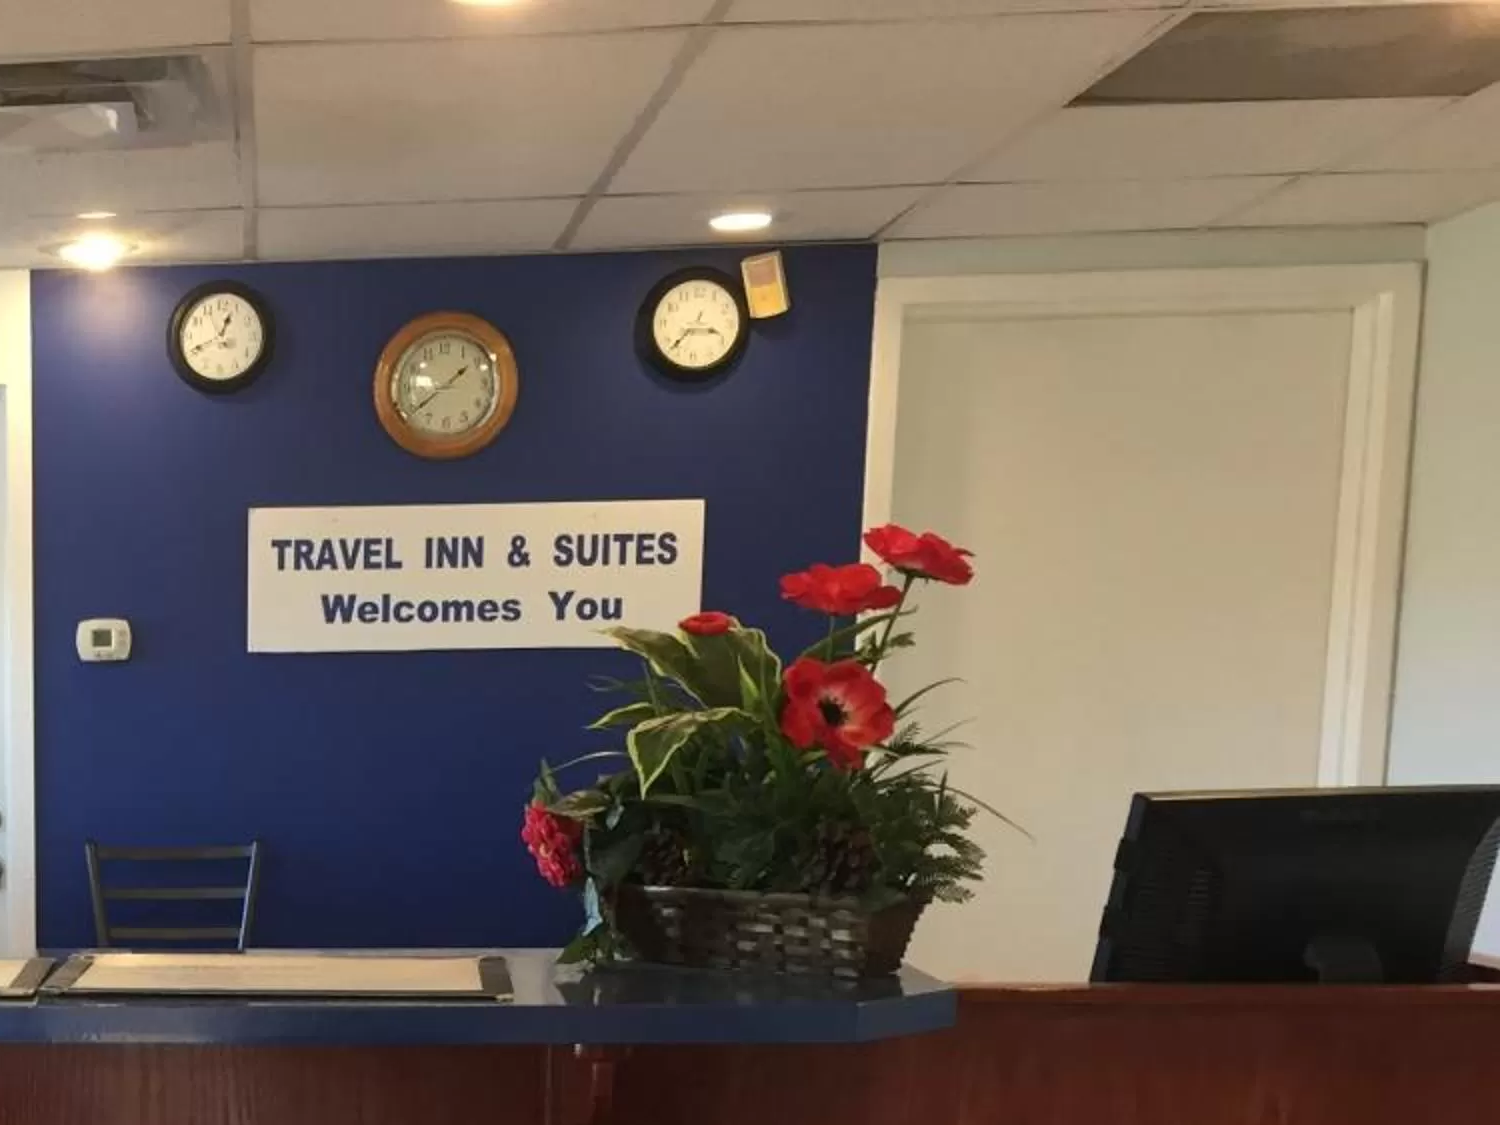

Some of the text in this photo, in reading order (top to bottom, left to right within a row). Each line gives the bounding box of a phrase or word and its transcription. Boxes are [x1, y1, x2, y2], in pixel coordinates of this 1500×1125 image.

[272, 532, 677, 570] TRAVEL INN & SUITES
[321, 591, 622, 624] Welcomes You
